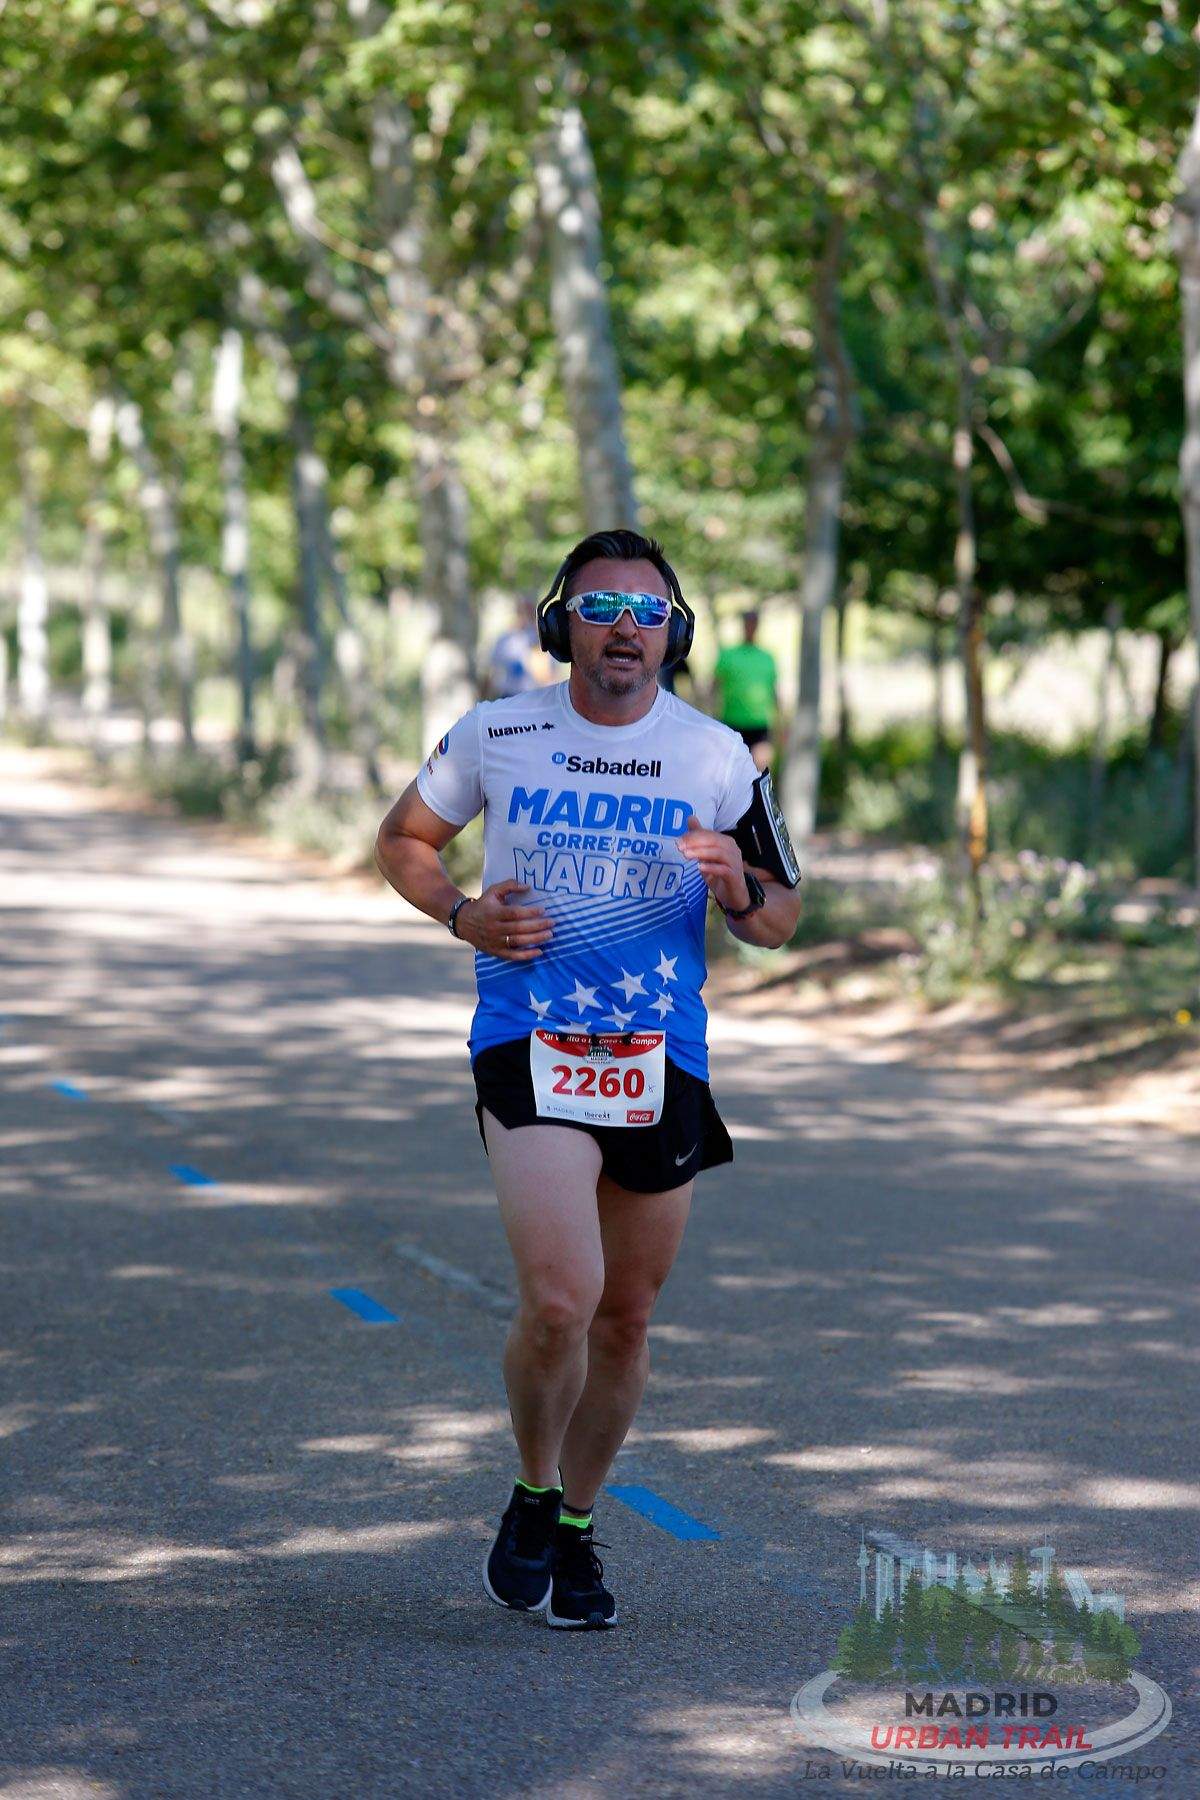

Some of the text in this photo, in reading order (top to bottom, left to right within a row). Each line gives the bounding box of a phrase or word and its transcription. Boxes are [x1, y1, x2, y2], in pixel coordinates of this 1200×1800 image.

[488, 724, 537, 739] luanvi
[566, 756, 662, 778] Sabadell
[508, 786, 694, 837] MADRID
[537, 831, 661, 857] CORRE POR
[513, 848, 684, 900] MADRID
[630, 1037, 658, 1046] Campo
[551, 1065, 645, 1099] 2260
